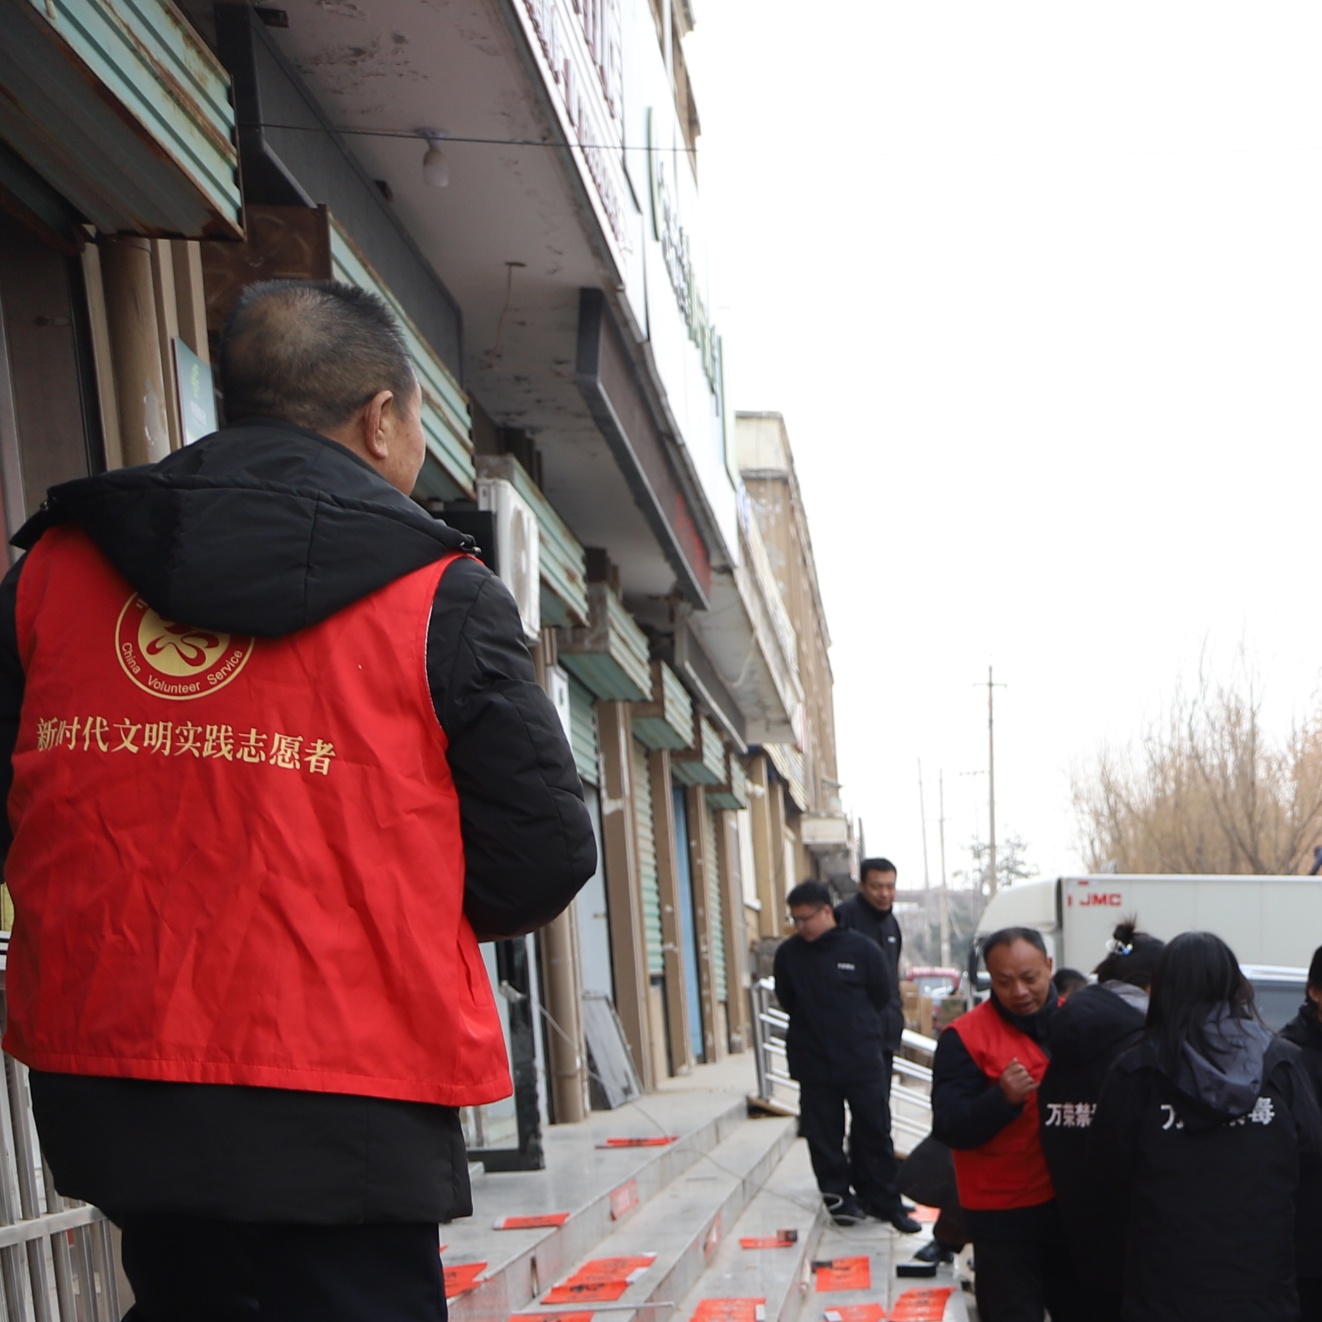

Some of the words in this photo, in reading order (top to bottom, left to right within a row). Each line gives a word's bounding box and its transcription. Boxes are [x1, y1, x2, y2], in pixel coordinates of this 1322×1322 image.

[122, 642, 141, 674] China
[147, 675, 201, 693] Volunteer
[206, 649, 243, 685] Service
[36, 715, 336, 776] 新时代文明实践志愿者
[1079, 892, 1122, 906] JMC
[1045, 1102, 1098, 1128] 万荣禁
